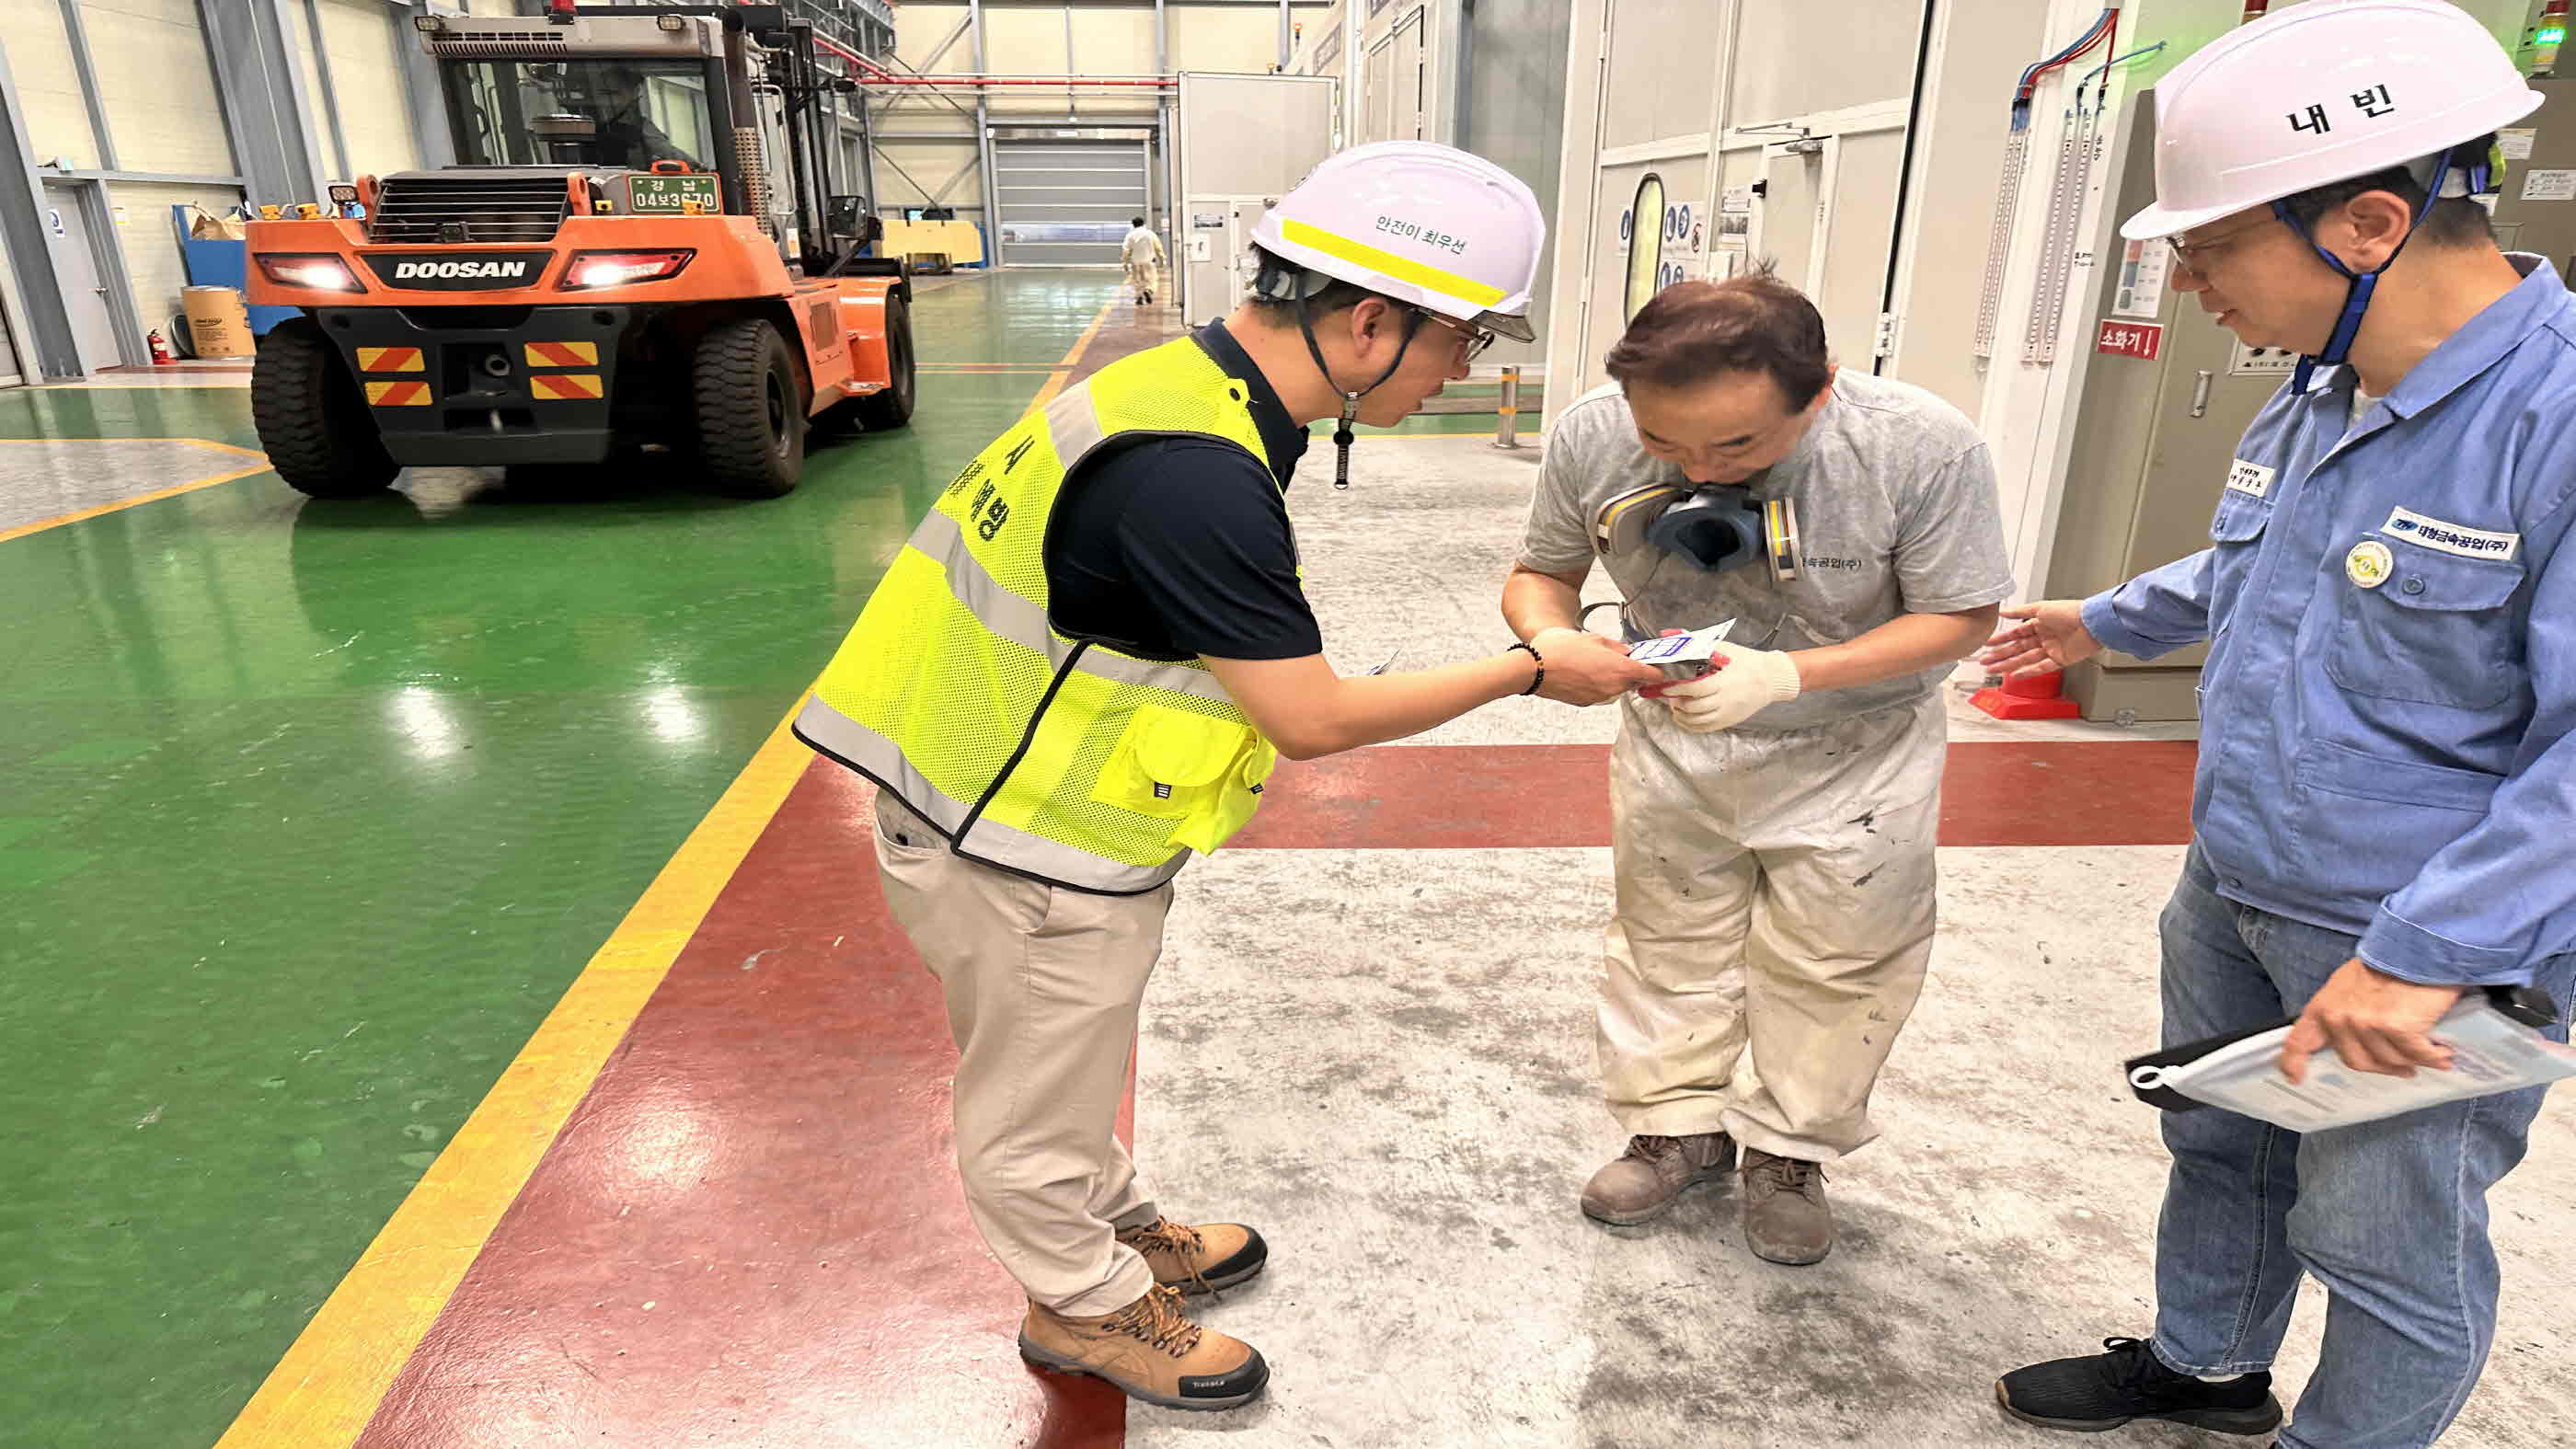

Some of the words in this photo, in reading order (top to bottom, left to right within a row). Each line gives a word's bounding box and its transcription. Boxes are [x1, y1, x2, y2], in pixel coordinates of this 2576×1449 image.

[1375, 215, 1421, 240] 안전이
[1421, 230, 1466, 255] 최우선
[395, 261, 526, 279] DOOSAN
[2099, 329, 2141, 352] 소화기
